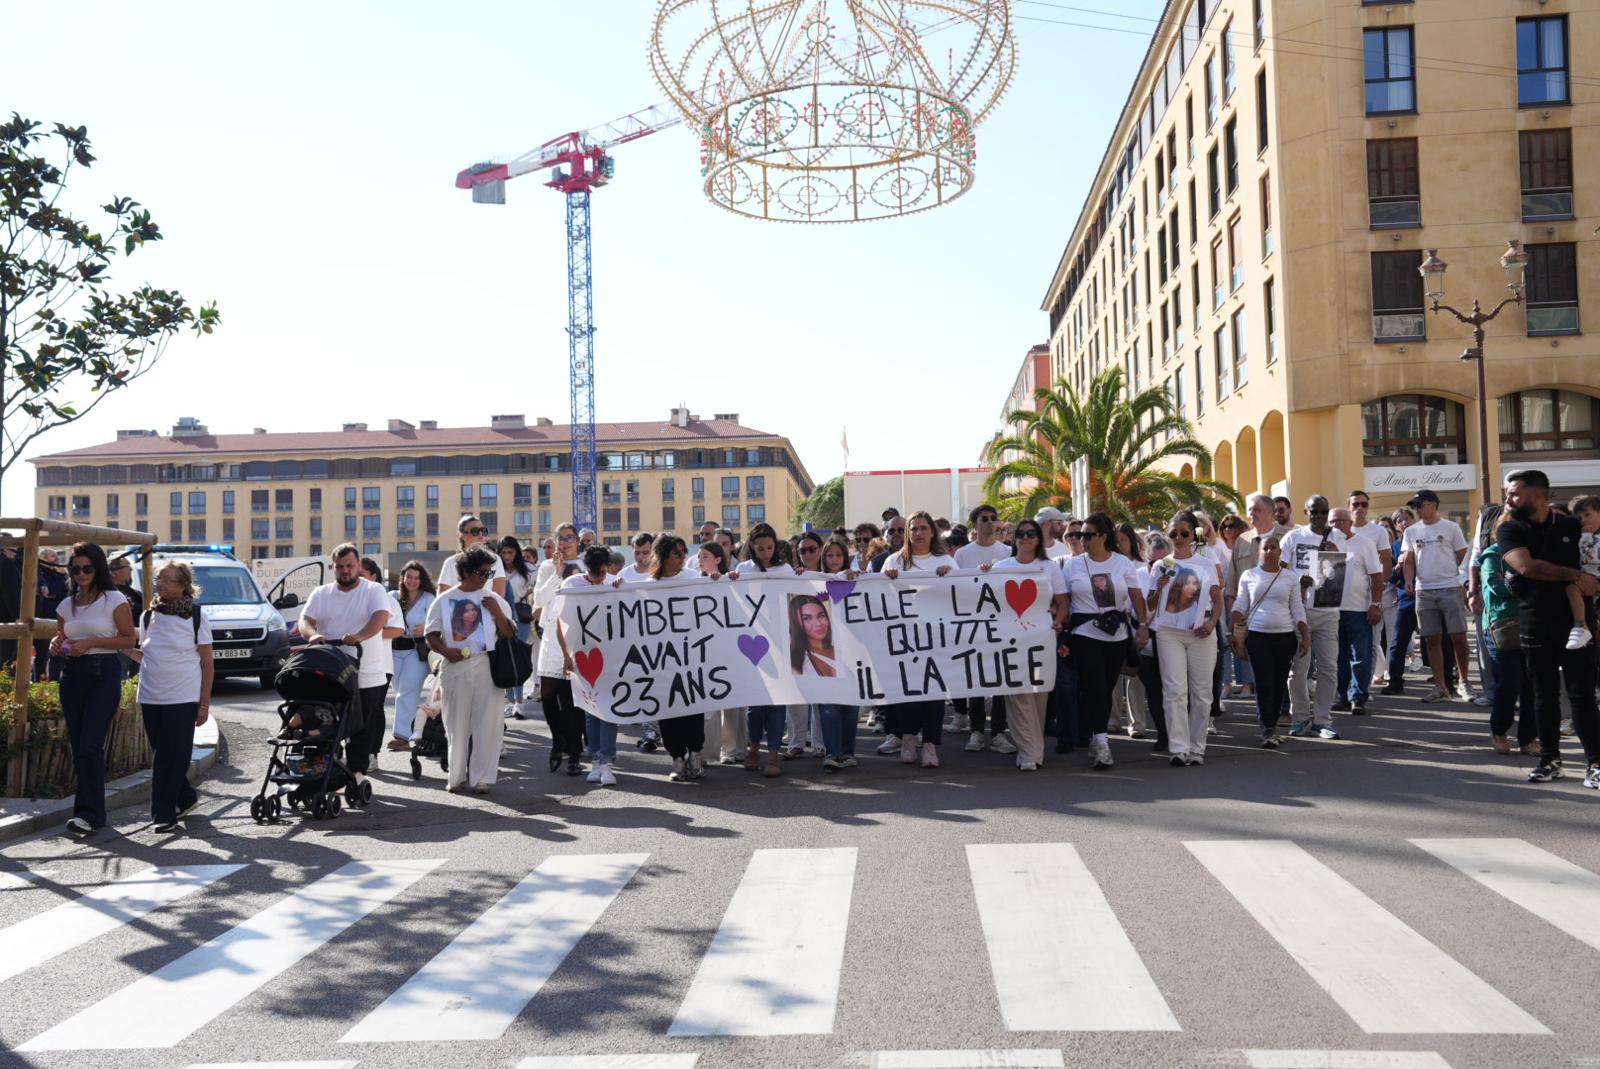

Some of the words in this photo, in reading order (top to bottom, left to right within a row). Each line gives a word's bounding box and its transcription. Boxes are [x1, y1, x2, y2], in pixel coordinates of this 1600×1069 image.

[1373, 472, 1417, 487] Maison
[1421, 471, 1465, 485] Blanche
[576, 594, 766, 646] KiMBERLY
[844, 589, 919, 624] ELLE
[610, 677, 660, 718] 23
[667, 666, 732, 708] ANS
[898, 656, 948, 697] L'A
[951, 638, 1045, 689] TUÉE
